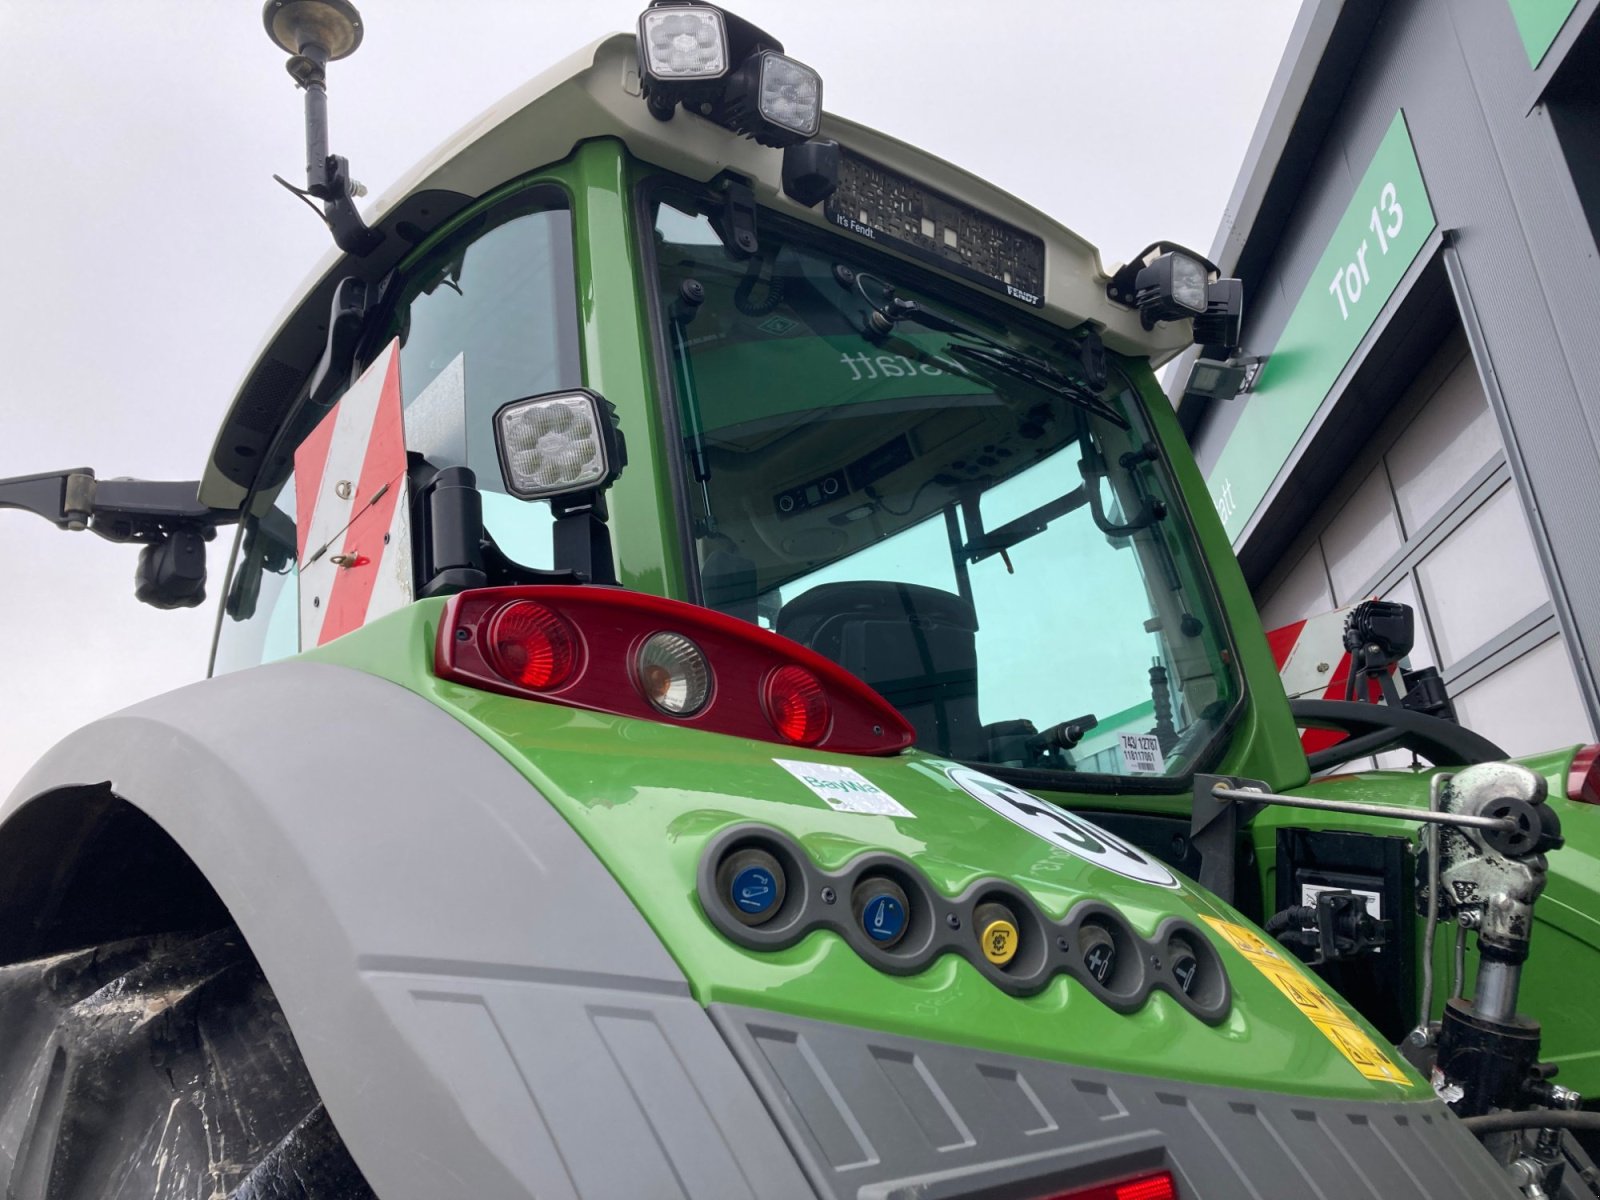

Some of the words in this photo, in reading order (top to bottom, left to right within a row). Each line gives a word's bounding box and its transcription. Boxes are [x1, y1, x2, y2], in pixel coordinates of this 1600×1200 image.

[836, 213, 849, 228] It's
[1329, 239, 1370, 320] Tor
[1369, 182, 1404, 255] 13
[1007, 285, 1039, 305] FENDT
[802, 776, 880, 793] BayWa
